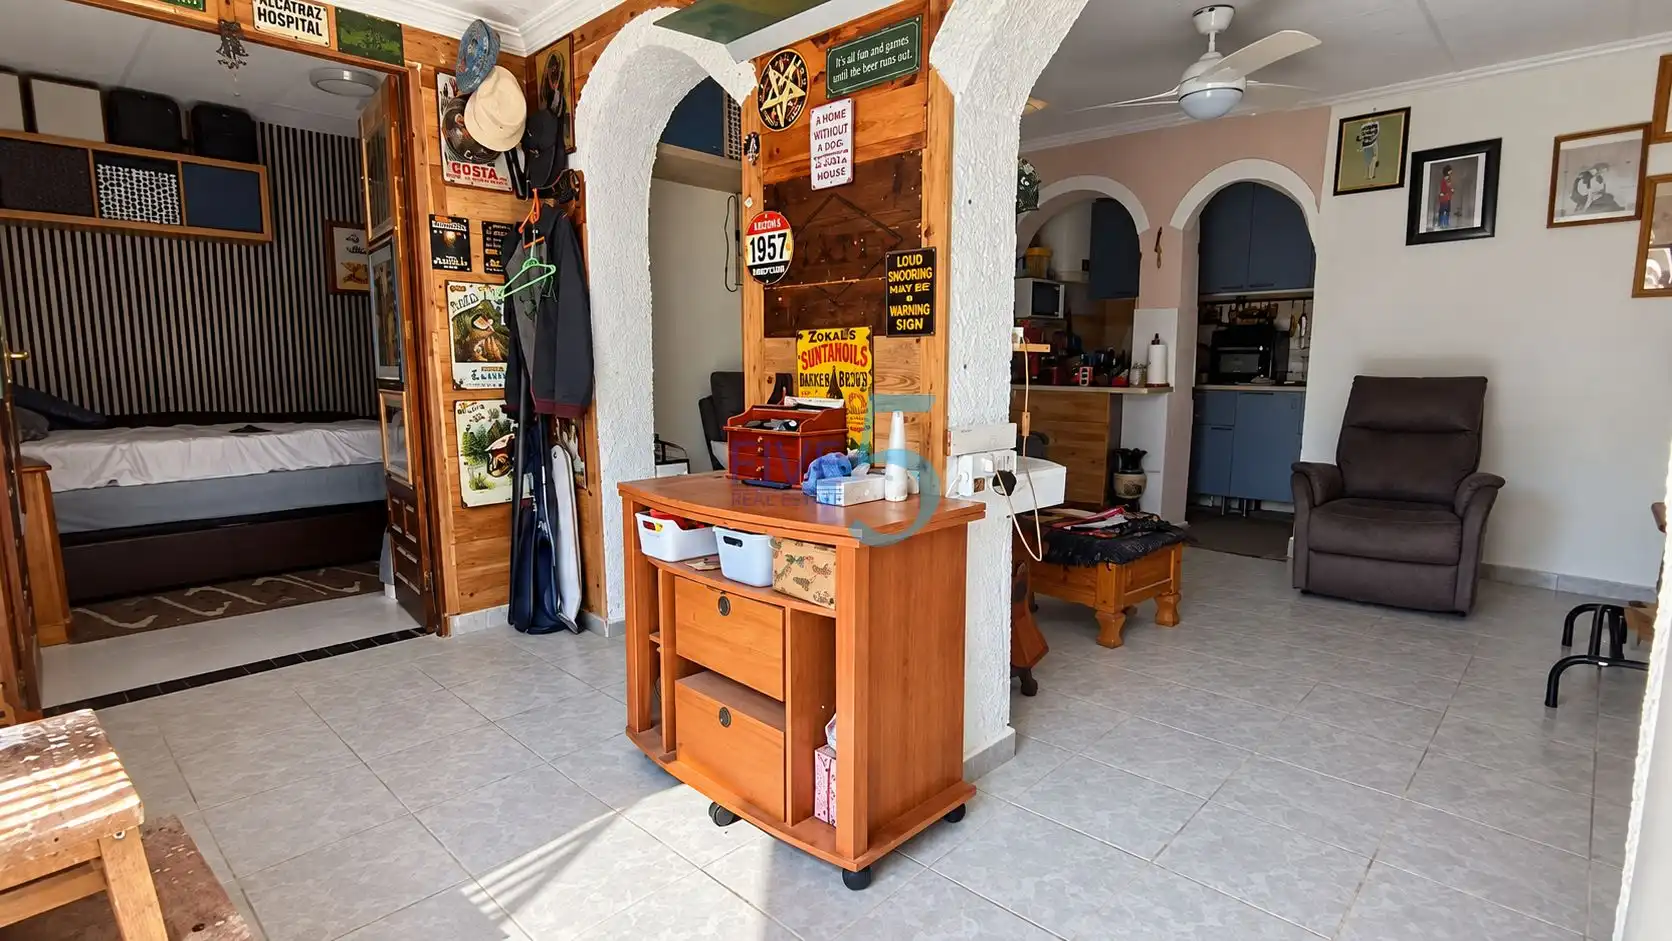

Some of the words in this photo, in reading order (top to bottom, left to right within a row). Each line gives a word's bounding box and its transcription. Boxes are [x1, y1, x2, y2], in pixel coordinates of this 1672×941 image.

[257, 6, 323, 37] HOSPITAL
[835, 55, 846, 68] It's
[846, 51, 856, 64] all
[857, 49, 869, 61] fun
[870, 42, 884, 56] and
[885, 36, 909, 54] games
[832, 68, 848, 83] until
[850, 66, 861, 78] the
[862, 61, 878, 74] beer
[880, 54, 897, 68] runs
[815, 115, 822, 126] A
[822, 108, 847, 124] HOME
[817, 143, 823, 152] A
[824, 139, 844, 151] DOG
[451, 162, 498, 180] COSTA
[817, 166, 846, 181] HOUSE
[749, 232, 788, 263] 1957
[896, 254, 923, 268] LOUD
[889, 283, 913, 294] MAY
[914, 282, 931, 293] BE
[889, 303, 931, 317] WARNING
[896, 317, 924, 331] SIGN
